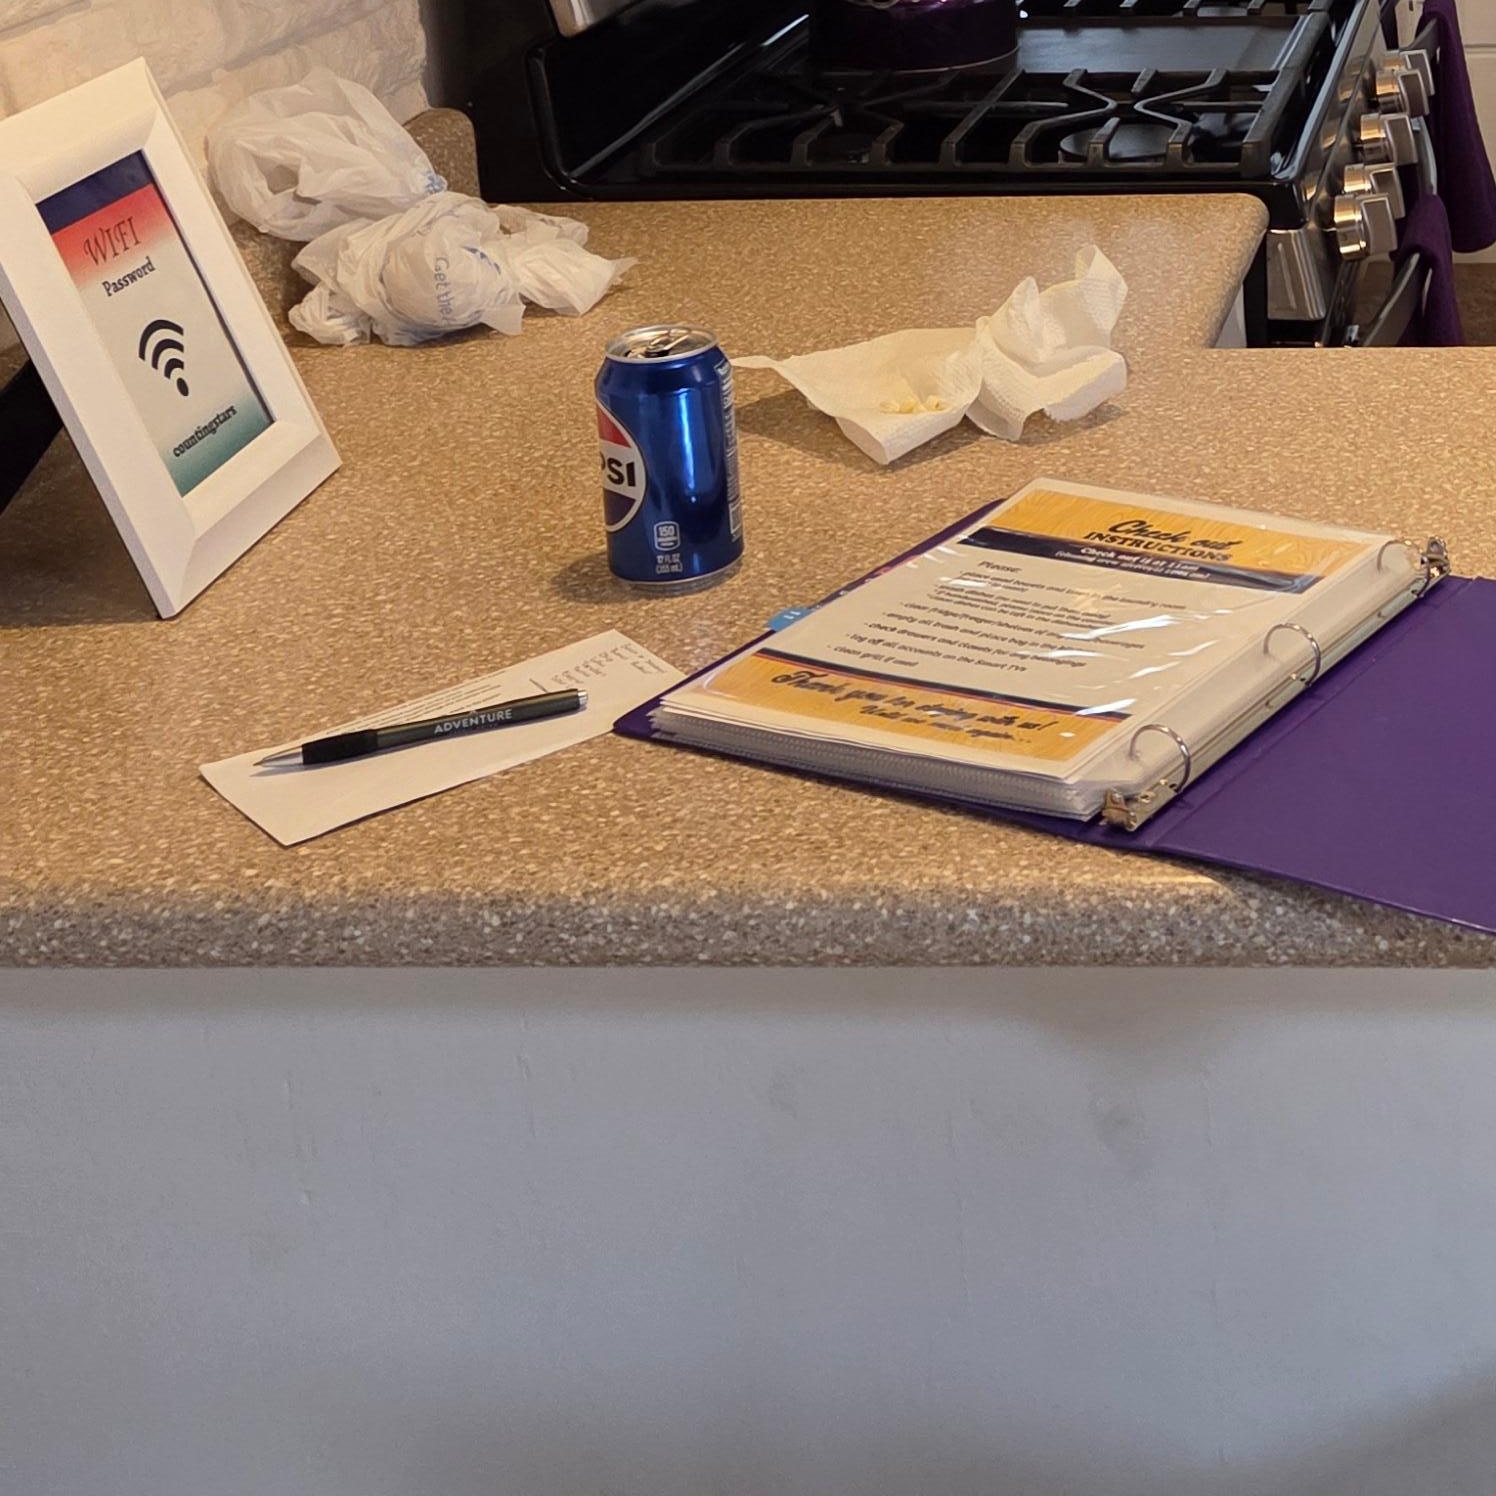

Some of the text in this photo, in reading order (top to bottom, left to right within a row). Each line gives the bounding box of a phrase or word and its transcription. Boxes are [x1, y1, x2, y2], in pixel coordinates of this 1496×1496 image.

[84, 216, 142, 266] WIFI
[102, 256, 156, 297] Password
[172, 405, 238, 458] countingstars
[1107, 518, 1192, 543] Check
[1083, 531, 1234, 562] INSTRUCTIONS
[771, 670, 850, 695] Thank
[433, 708, 513, 735] ADVENTURE
